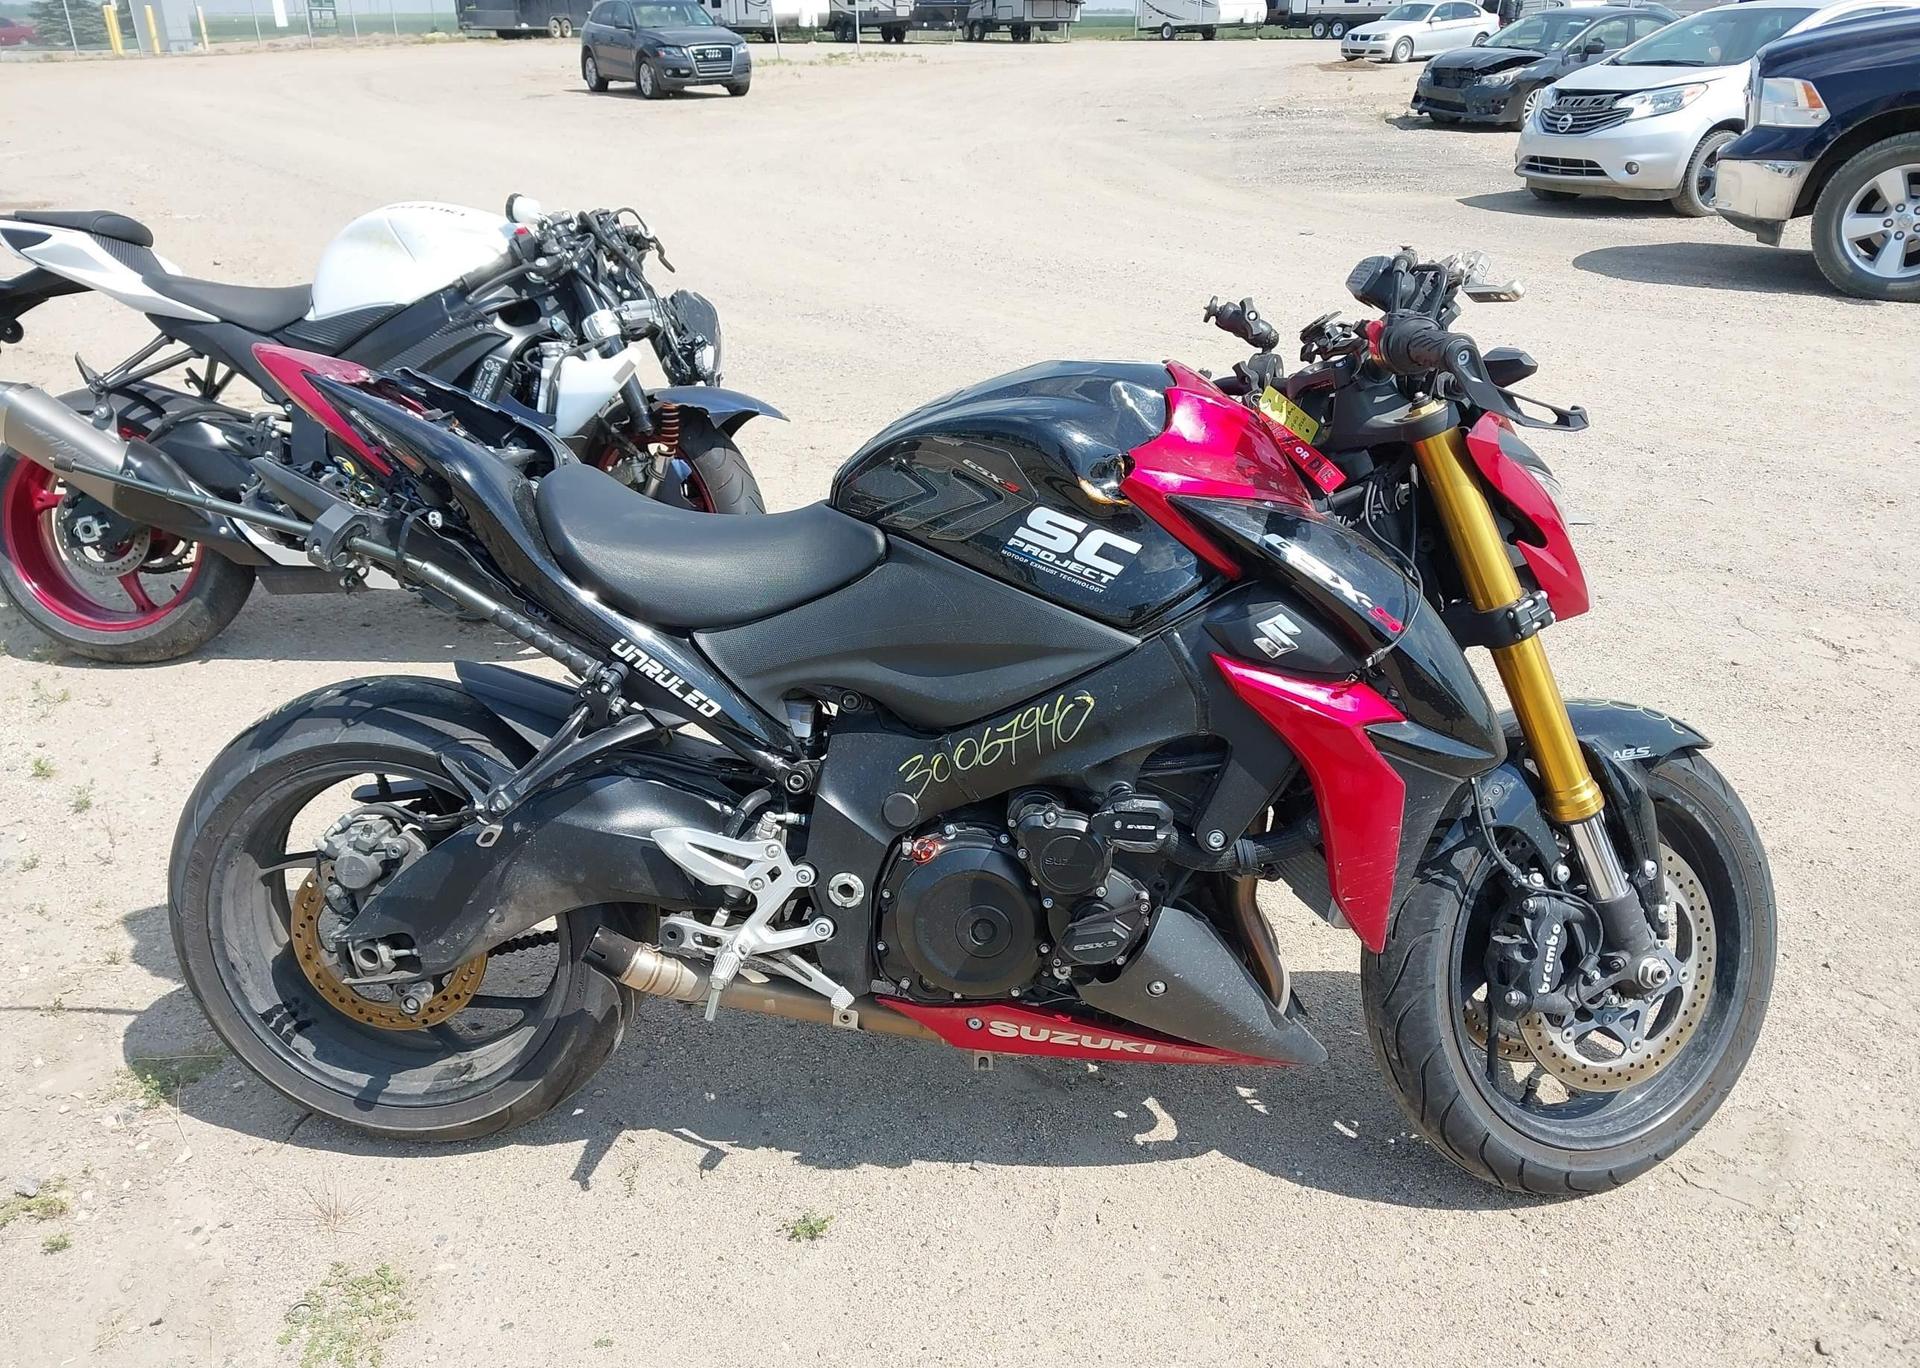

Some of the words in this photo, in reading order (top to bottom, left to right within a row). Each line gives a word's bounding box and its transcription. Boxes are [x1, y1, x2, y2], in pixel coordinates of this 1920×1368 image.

[1294, 445, 1311, 460] OR
[1007, 537, 1115, 584] PROJECT
[1014, 506, 1143, 576] SC
[1001, 549, 1029, 564] MOTOGP
[1030, 561, 1058, 576] EXHAUST
[1059, 572, 1105, 594] TECHNOLOGY
[611, 638, 722, 718] UNRULED
[1613, 746, 1652, 760] ABS
[1537, 923, 1561, 994] brembo
[987, 1020, 1157, 1054] SUZUKI
